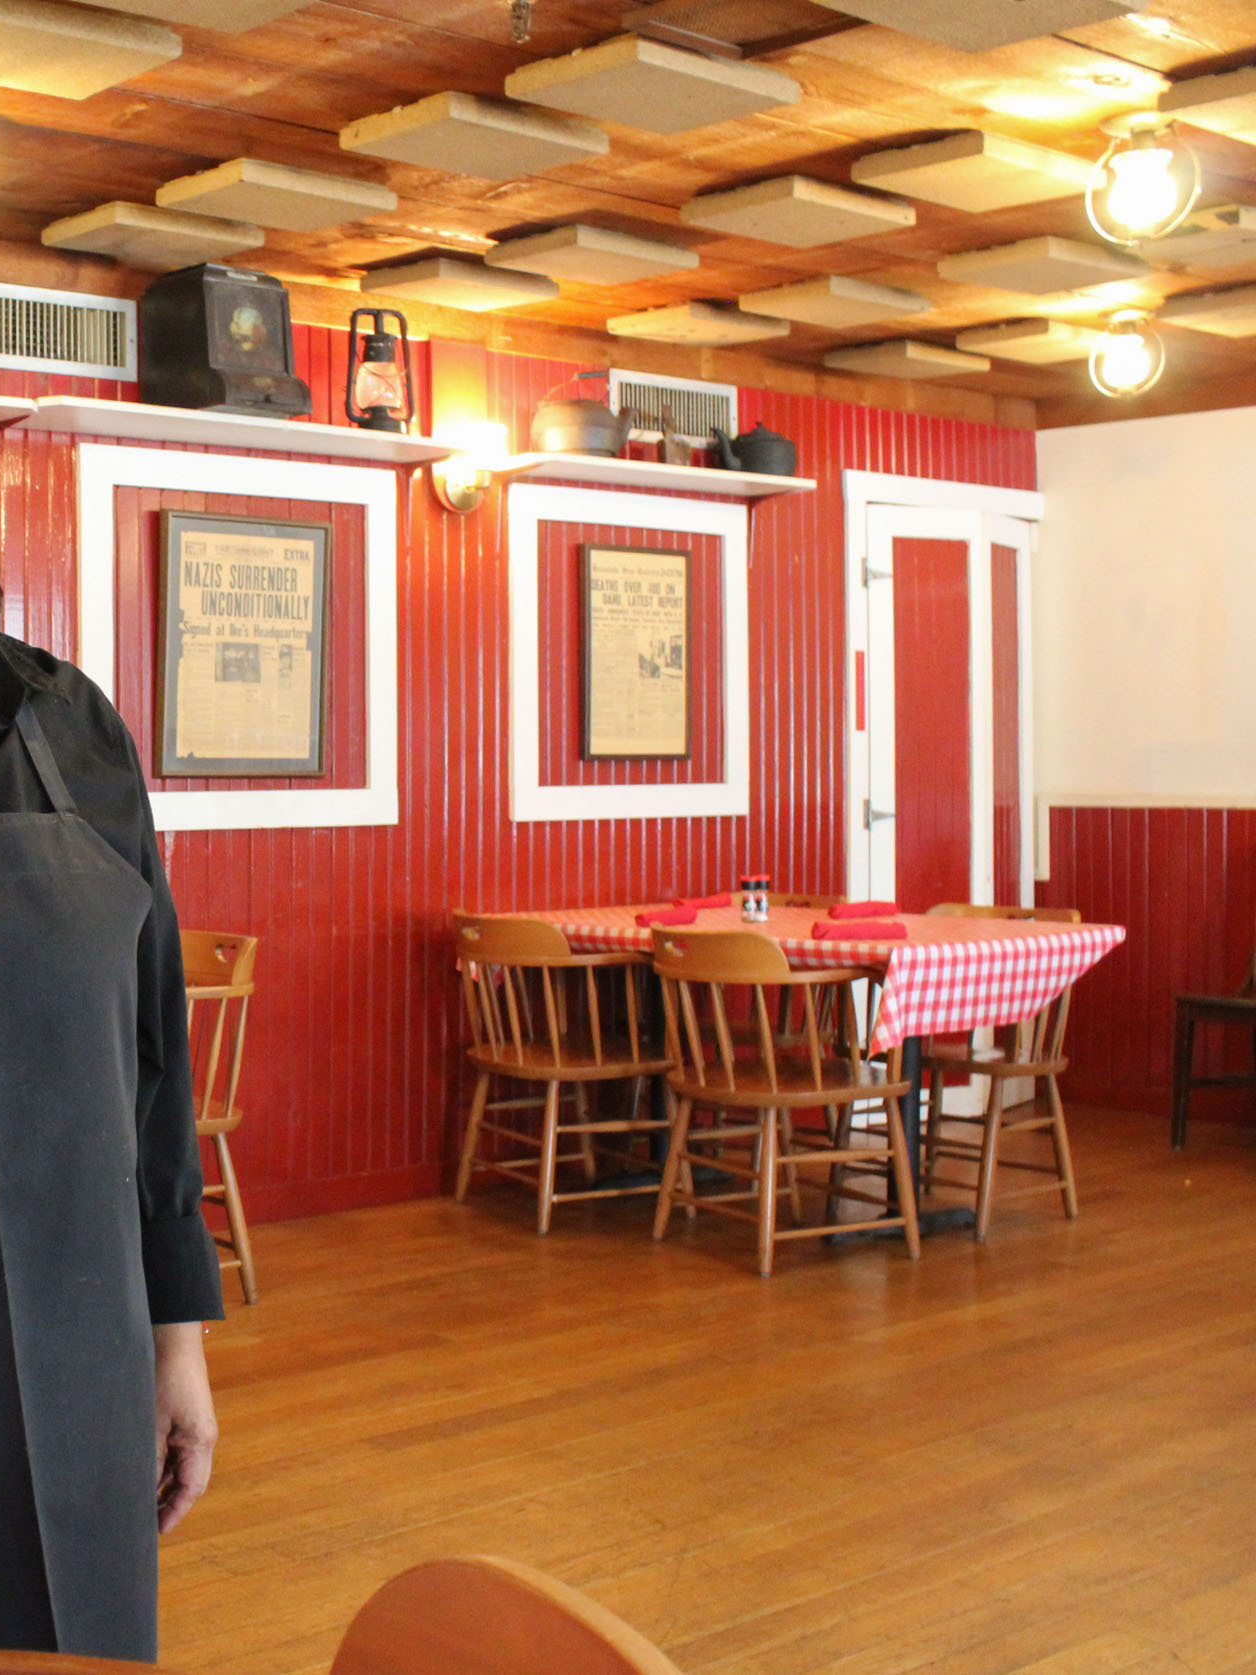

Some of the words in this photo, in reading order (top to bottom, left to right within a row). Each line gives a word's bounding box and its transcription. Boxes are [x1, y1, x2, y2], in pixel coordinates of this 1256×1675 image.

[184, 560, 222, 588] NAZIS
[230, 563, 297, 592] SURRENDER
[201, 589, 310, 620] UNCONDITIONALLY
[183, 621, 211, 639] Signed
[216, 624, 224, 635] at
